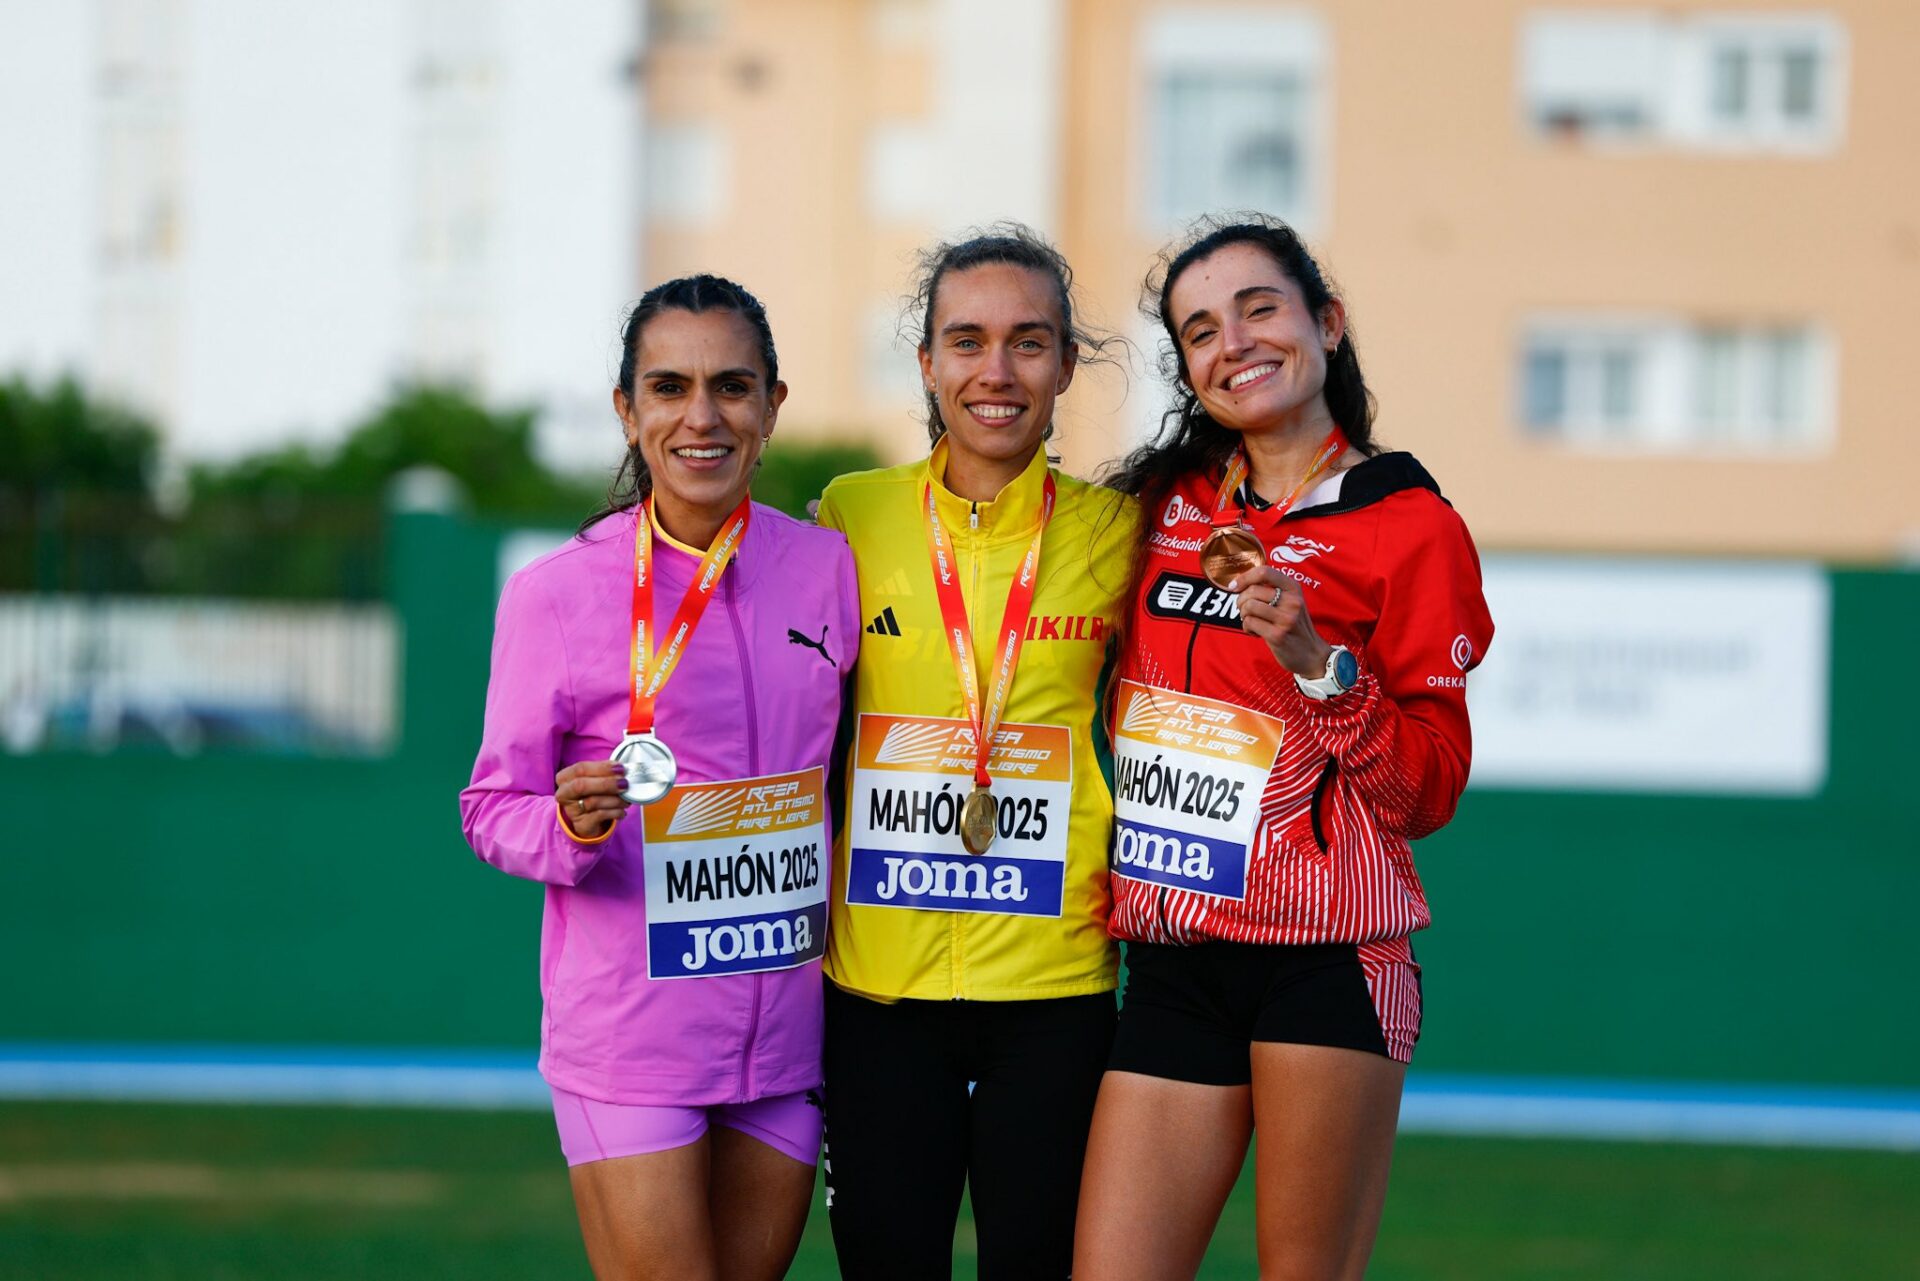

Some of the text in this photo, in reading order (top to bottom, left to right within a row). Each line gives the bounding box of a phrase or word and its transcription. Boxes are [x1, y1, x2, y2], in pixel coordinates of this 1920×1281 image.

[714, 517, 744, 562] ATLETISMO
[937, 550, 951, 585] RFEA
[1020, 550, 1033, 587] RFEA
[661, 621, 689, 671] ATLETISMO
[953, 627, 974, 698] ATLETISMO
[996, 629, 1017, 702] ATLETISMO
[1426, 675, 1466, 688] OREKA
[1174, 703, 1236, 725] RFEA
[954, 727, 1024, 745] REA
[1155, 729, 1244, 756] AIRE LIBRE
[1163, 717, 1260, 745] ATLETISMO
[939, 757, 1039, 775] AIRE LIBRE
[741, 793, 815, 816] ATLETISMO
[746, 781, 800, 803] RFEA
[1180, 771, 1245, 822] 2025
[736, 810, 811, 830] AIRE LIBRE
[994, 796, 1049, 841] 025
[666, 842, 819, 904] MAHÓN 2025
